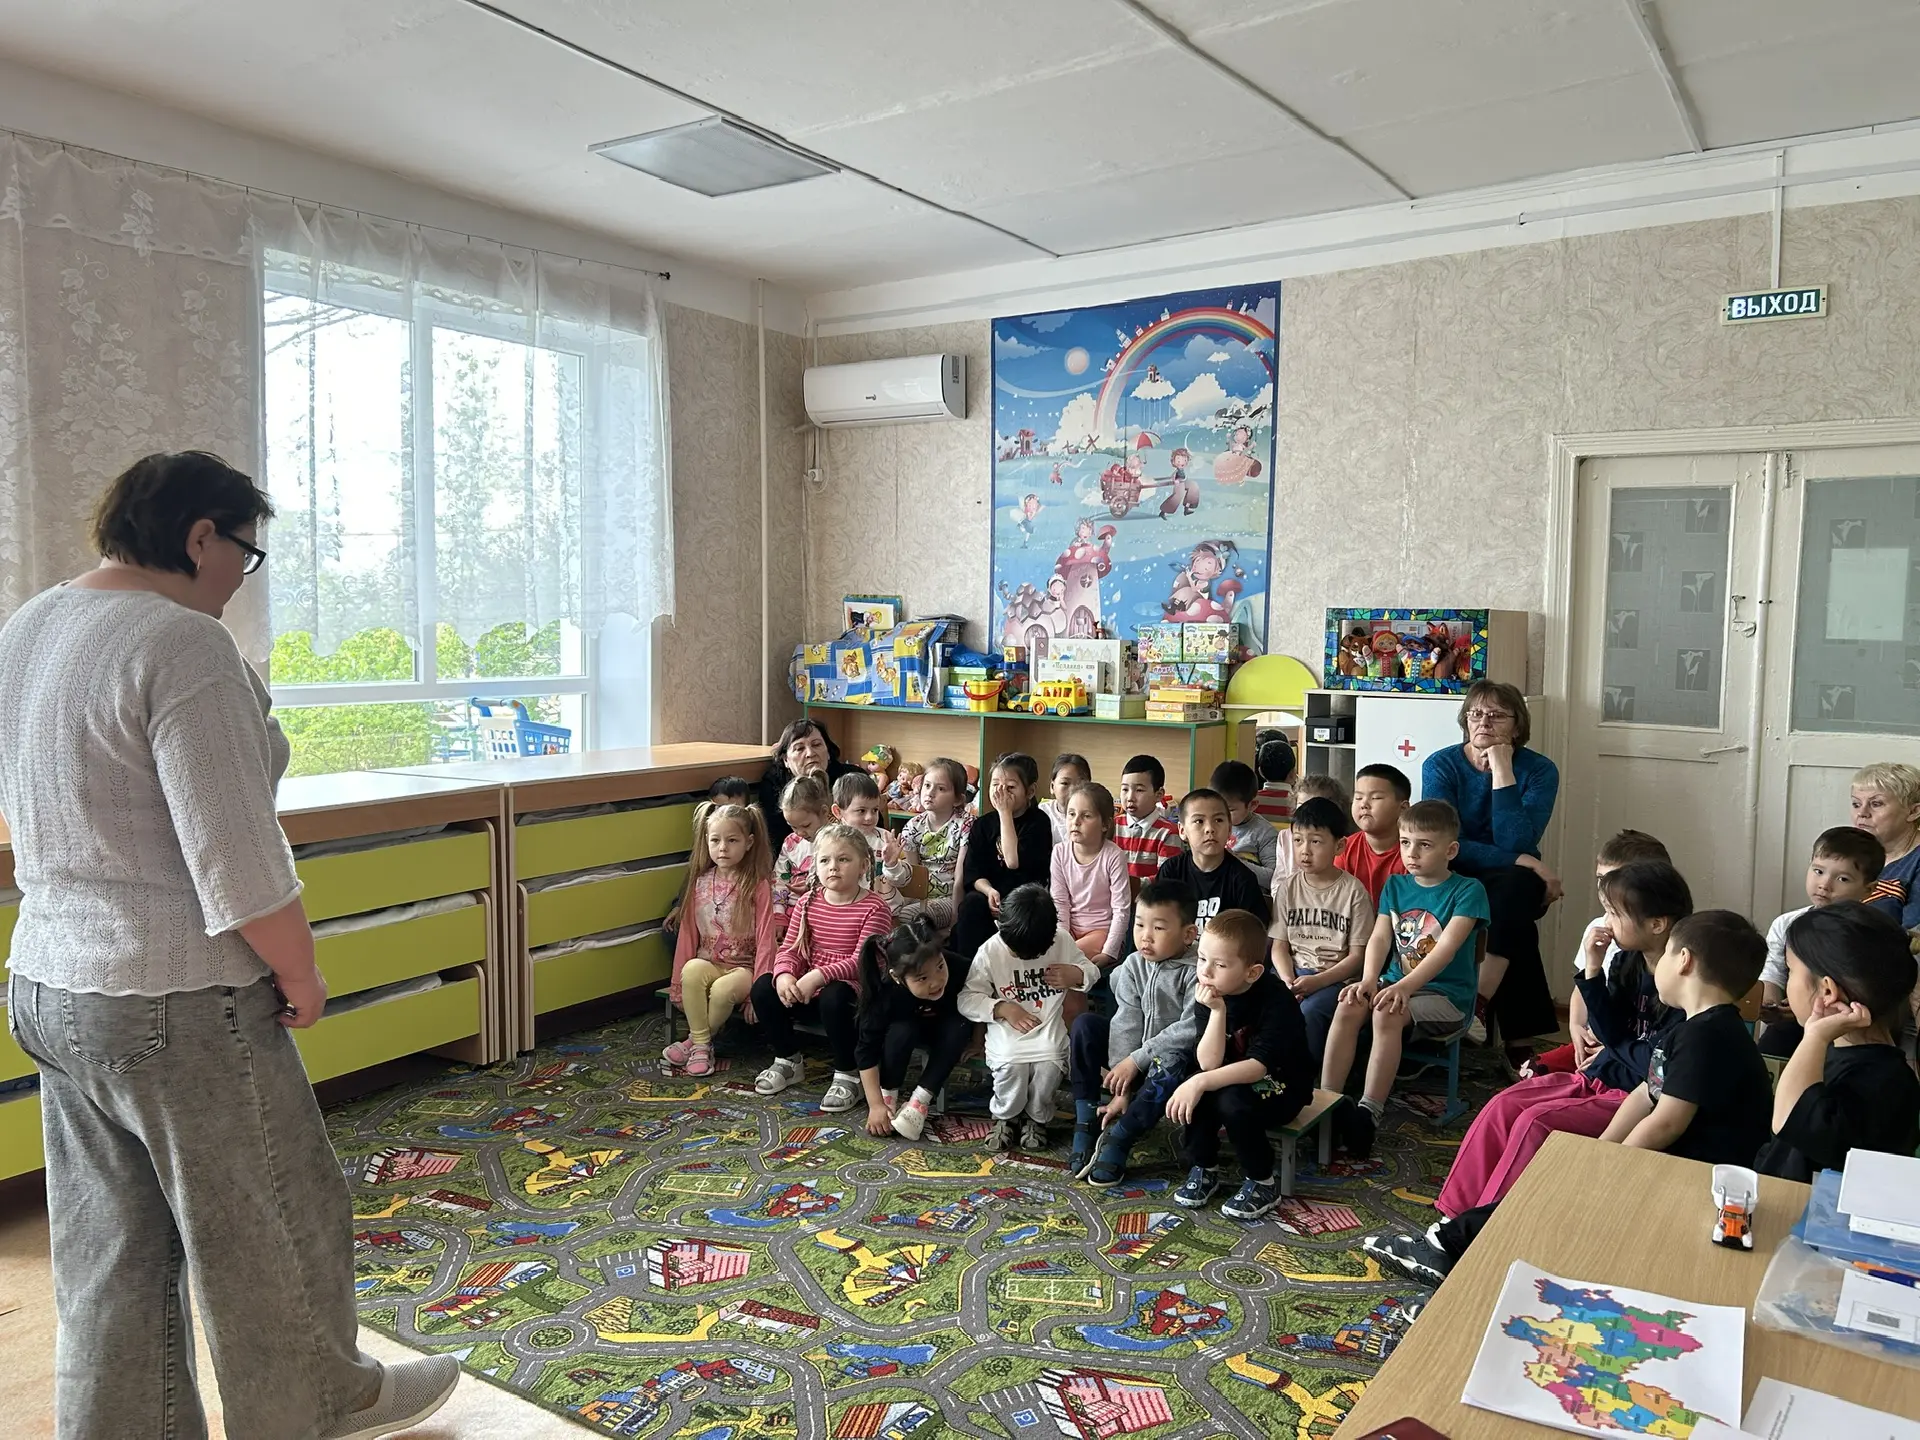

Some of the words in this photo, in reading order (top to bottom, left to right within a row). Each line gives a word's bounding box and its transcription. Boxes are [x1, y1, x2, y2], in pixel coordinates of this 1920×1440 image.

[1731, 292, 1816, 318] ВЫХОД
[1288, 908, 1351, 934] HALLENGE
[1013, 967, 1047, 988] Litt
[1017, 985, 1063, 1002] Broth
